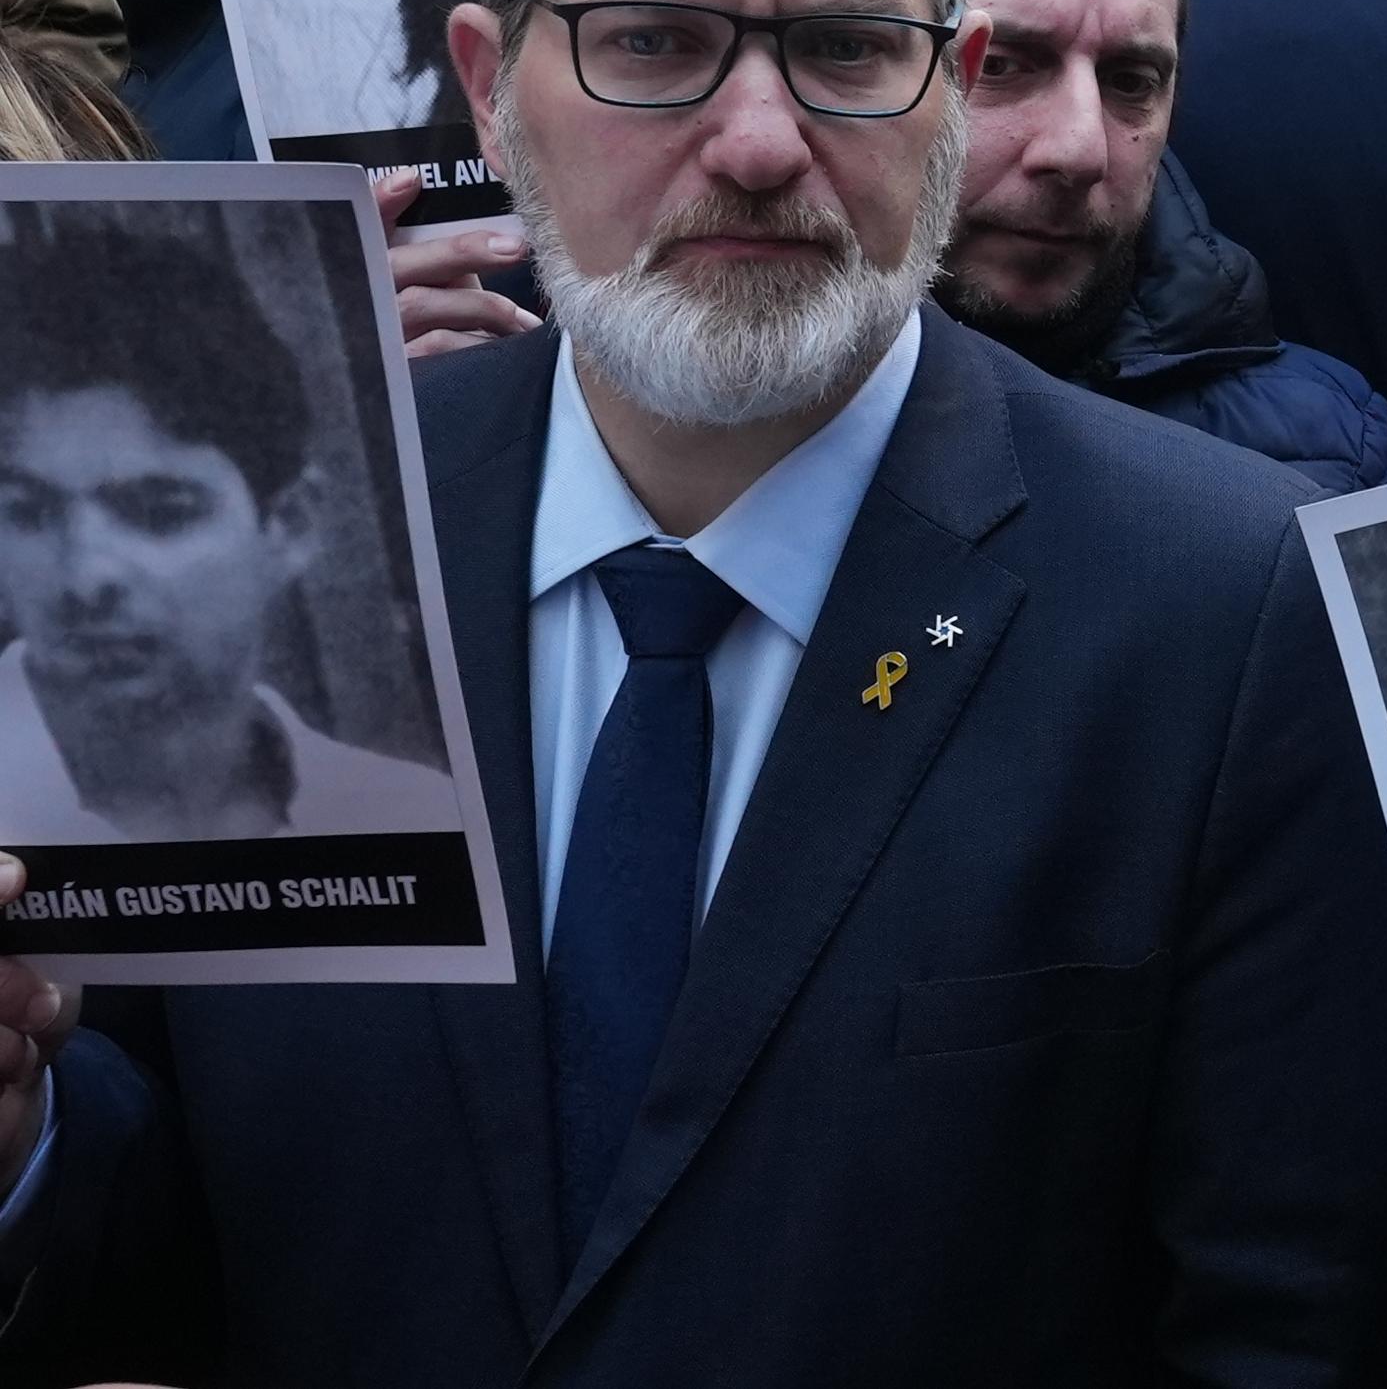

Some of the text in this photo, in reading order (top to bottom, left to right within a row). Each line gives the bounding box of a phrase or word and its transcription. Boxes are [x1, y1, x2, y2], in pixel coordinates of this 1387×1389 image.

[4, 875, 417, 921] ABIÁN GUSTAVO SCHALIT
